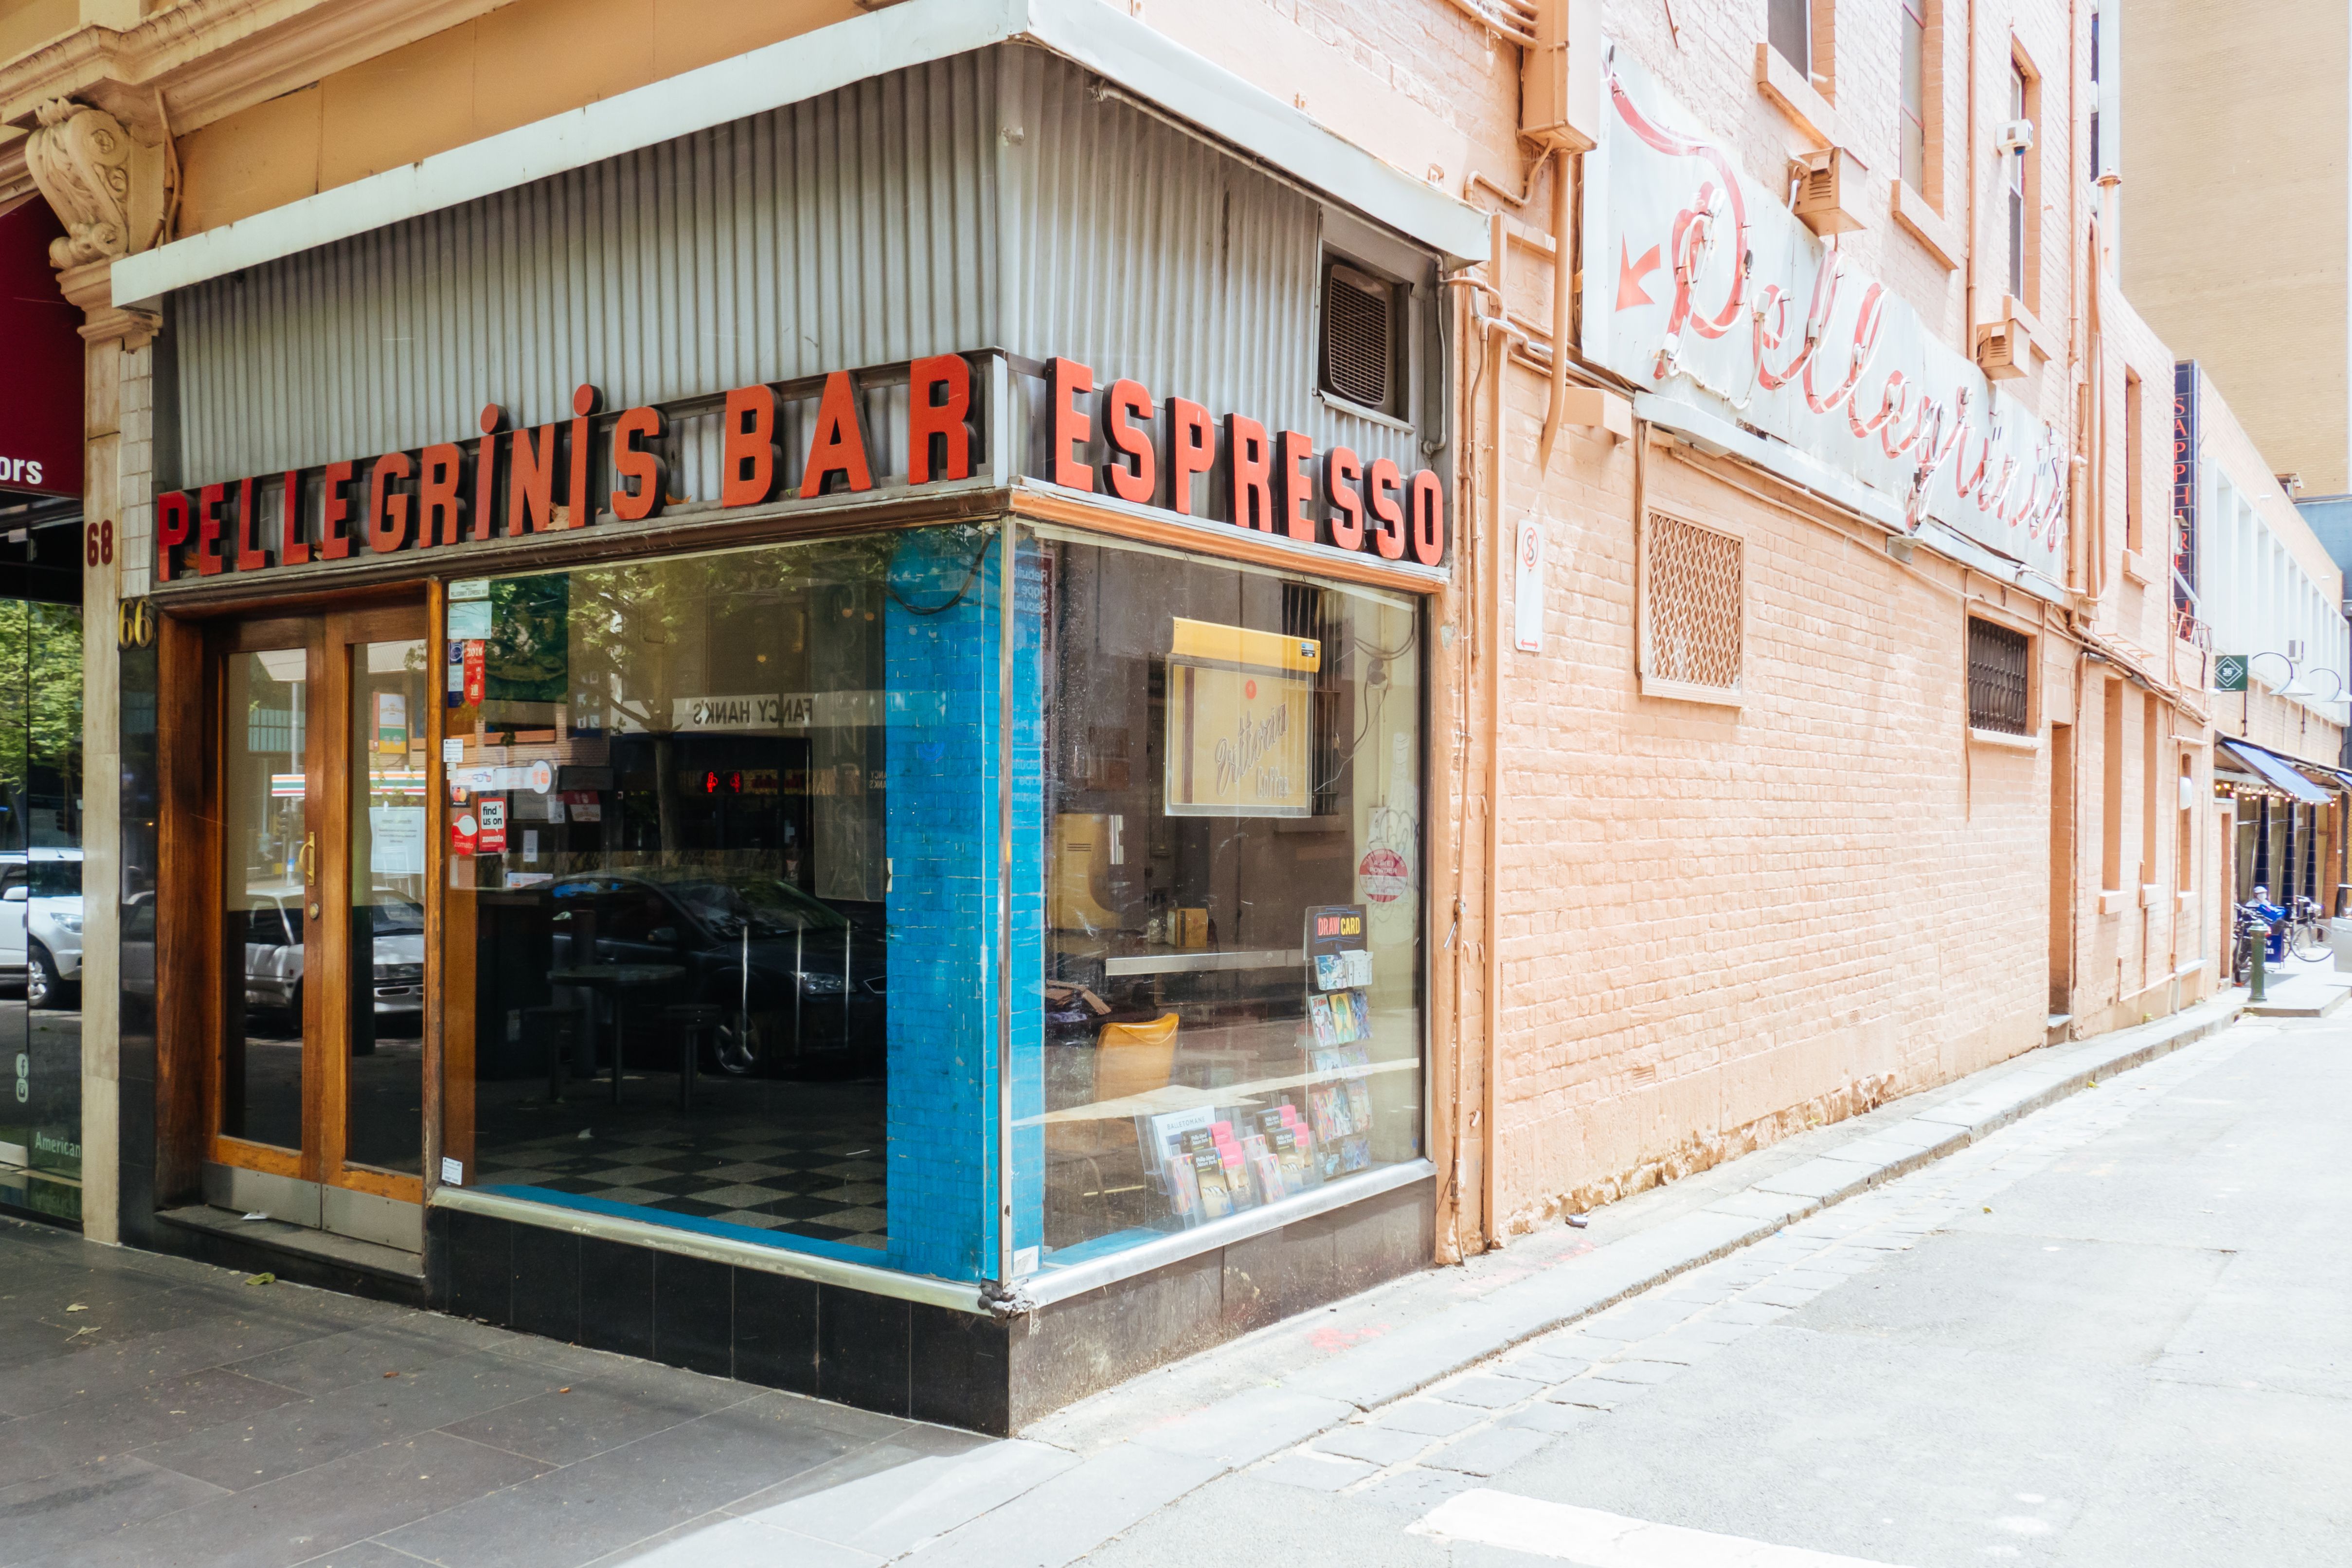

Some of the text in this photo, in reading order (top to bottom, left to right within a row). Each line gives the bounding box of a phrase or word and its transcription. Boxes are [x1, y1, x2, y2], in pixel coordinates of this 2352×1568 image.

[723, 353, 975, 509] BAR
[1046, 357, 1443, 567] ESPRESSO
[87, 520, 113, 567] 68
[119, 598, 153, 649] 66
[467, 648, 483, 657] 2016
[1257, 766, 1289, 798] Coffee
[483, 806, 497, 815] find
[1317, 917, 1361, 936] DRAW CARD
[1167, 1117, 1205, 1130] BALLETOMANE
[35, 1131, 81, 1158] American
